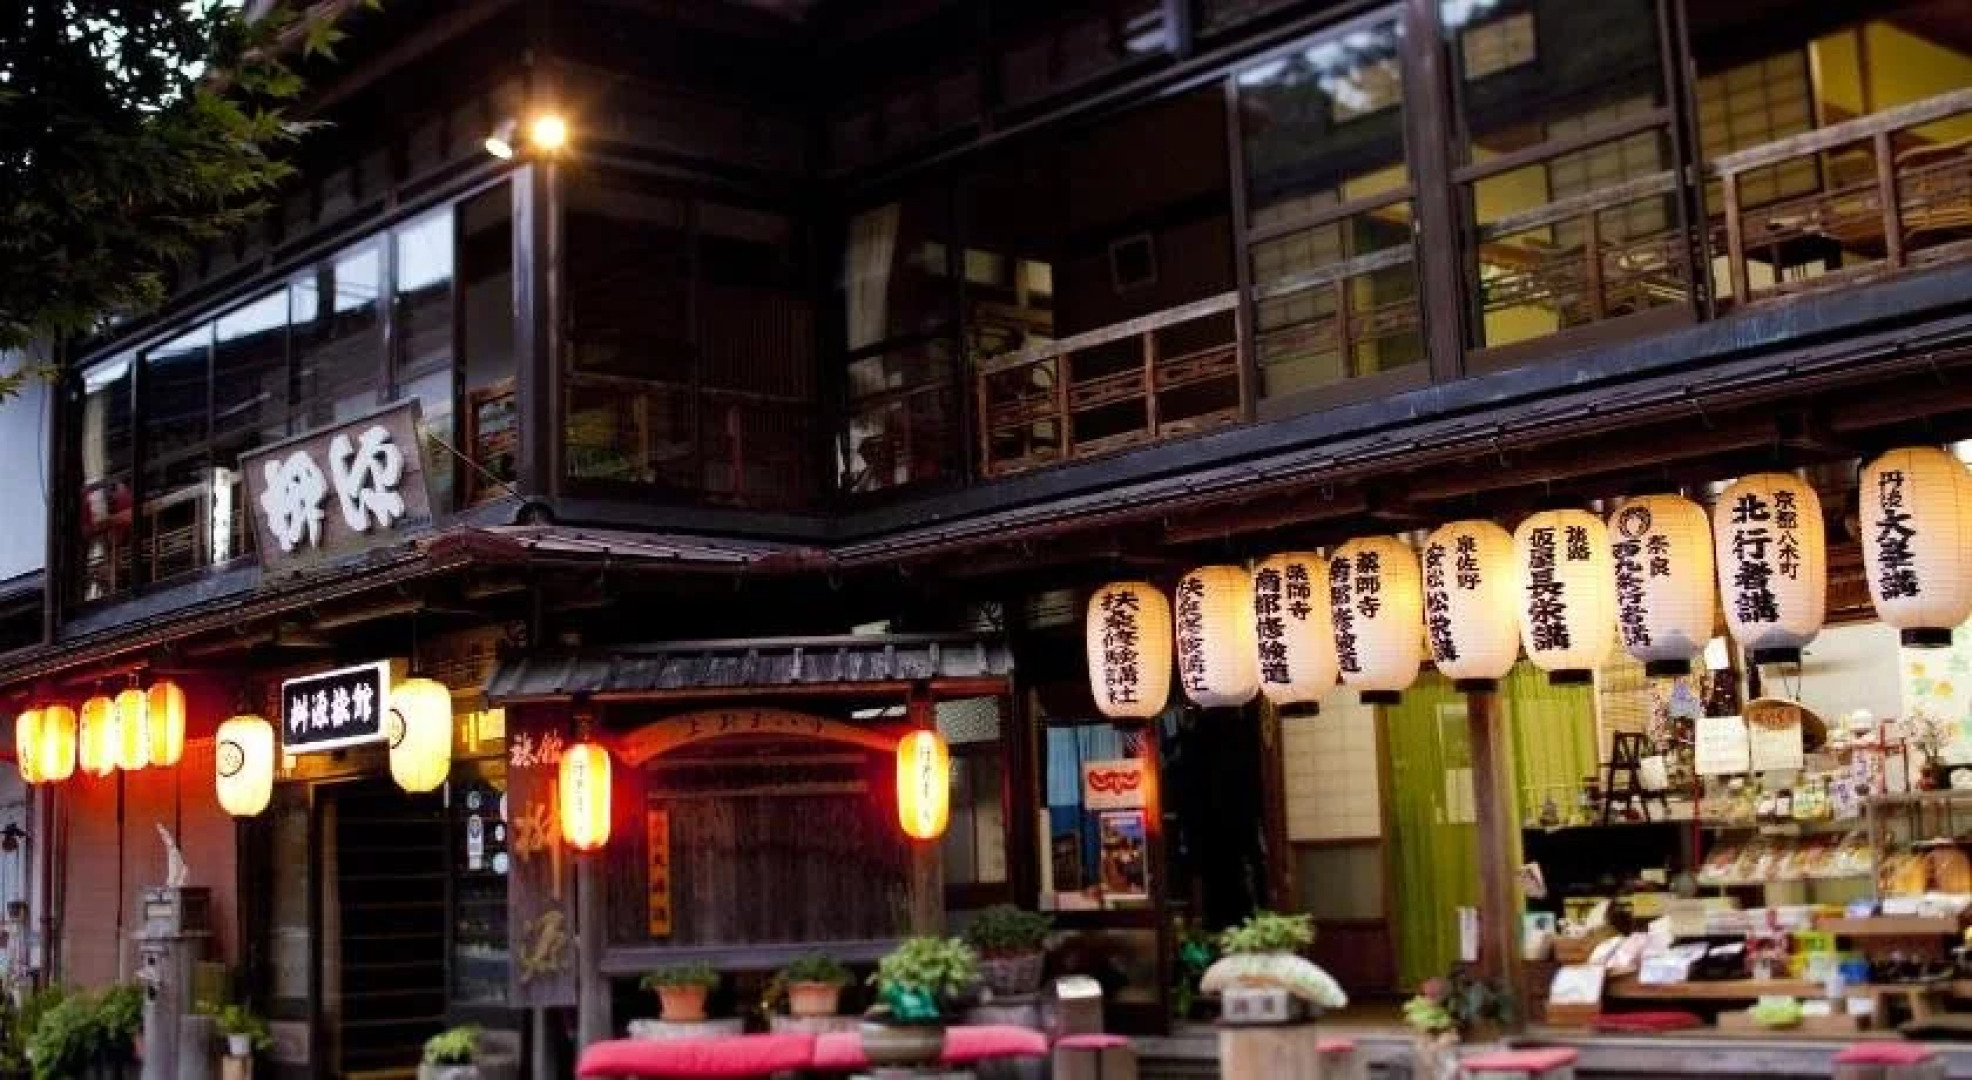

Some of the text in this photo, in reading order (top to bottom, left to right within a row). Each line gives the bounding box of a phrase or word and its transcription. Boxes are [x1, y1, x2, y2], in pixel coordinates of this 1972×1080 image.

[1456, 535, 1482, 590] 泉佐野
[1646, 535, 1670, 577] 奈良
[1732, 493, 1780, 623] 北行者講
[1773, 490, 1800, 581] 京都八木町
[1286, 562, 1312, 620] 薬師寺
[1355, 551, 1381, 618] 薬師寺
